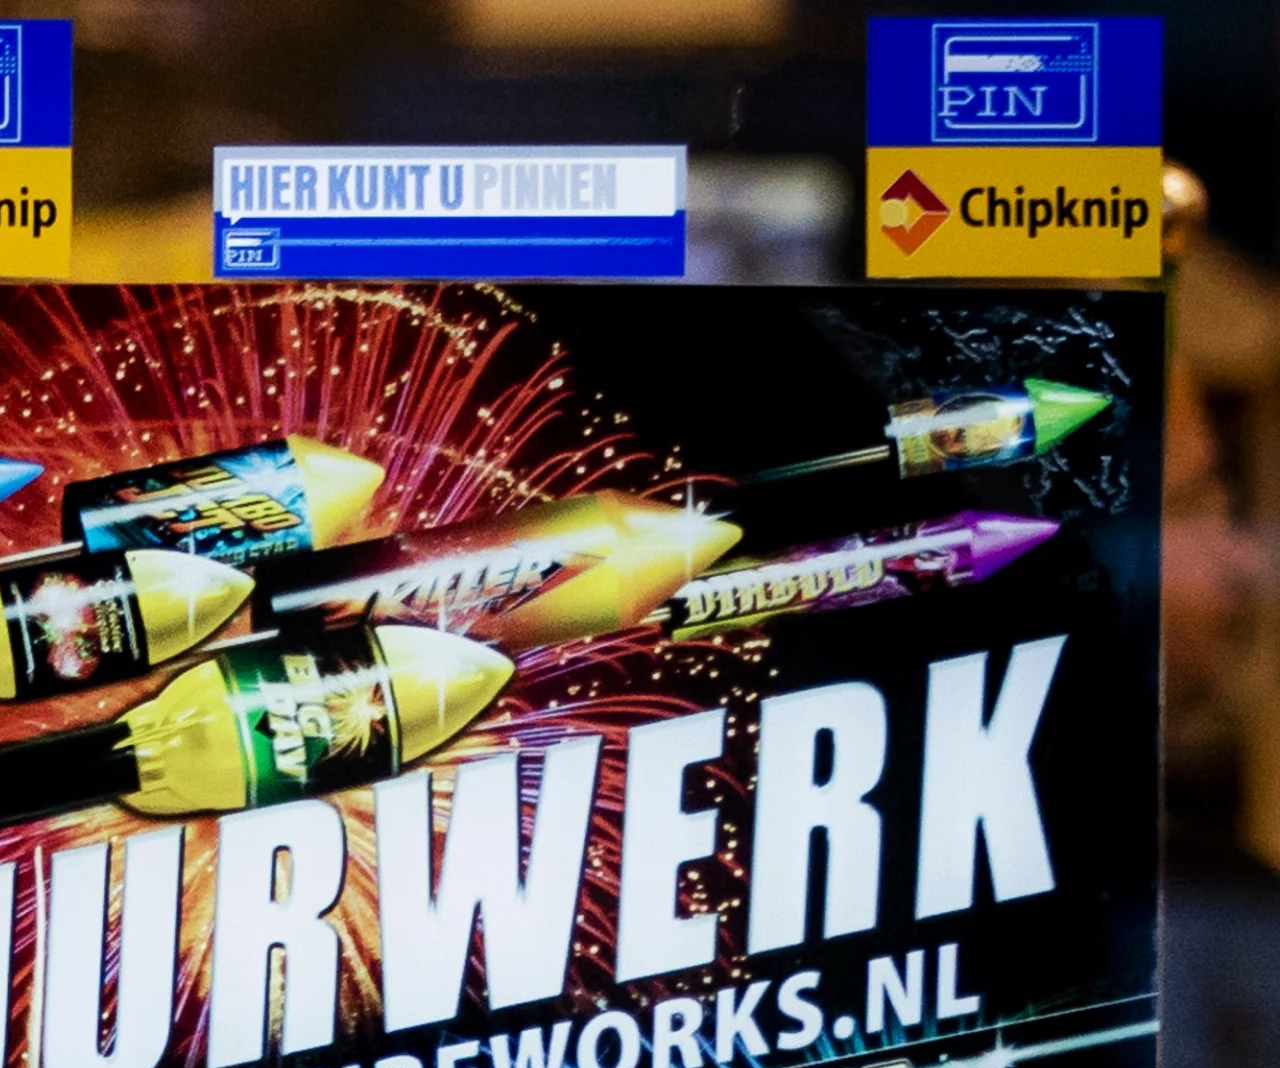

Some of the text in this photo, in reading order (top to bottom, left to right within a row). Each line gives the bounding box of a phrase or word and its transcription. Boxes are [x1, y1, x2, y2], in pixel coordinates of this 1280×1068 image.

[938, 85, 1048, 117] PIN
[230, 163, 617, 211] HIER KUNT U PINNEN
[959, 186, 1149, 238] Chipknip
